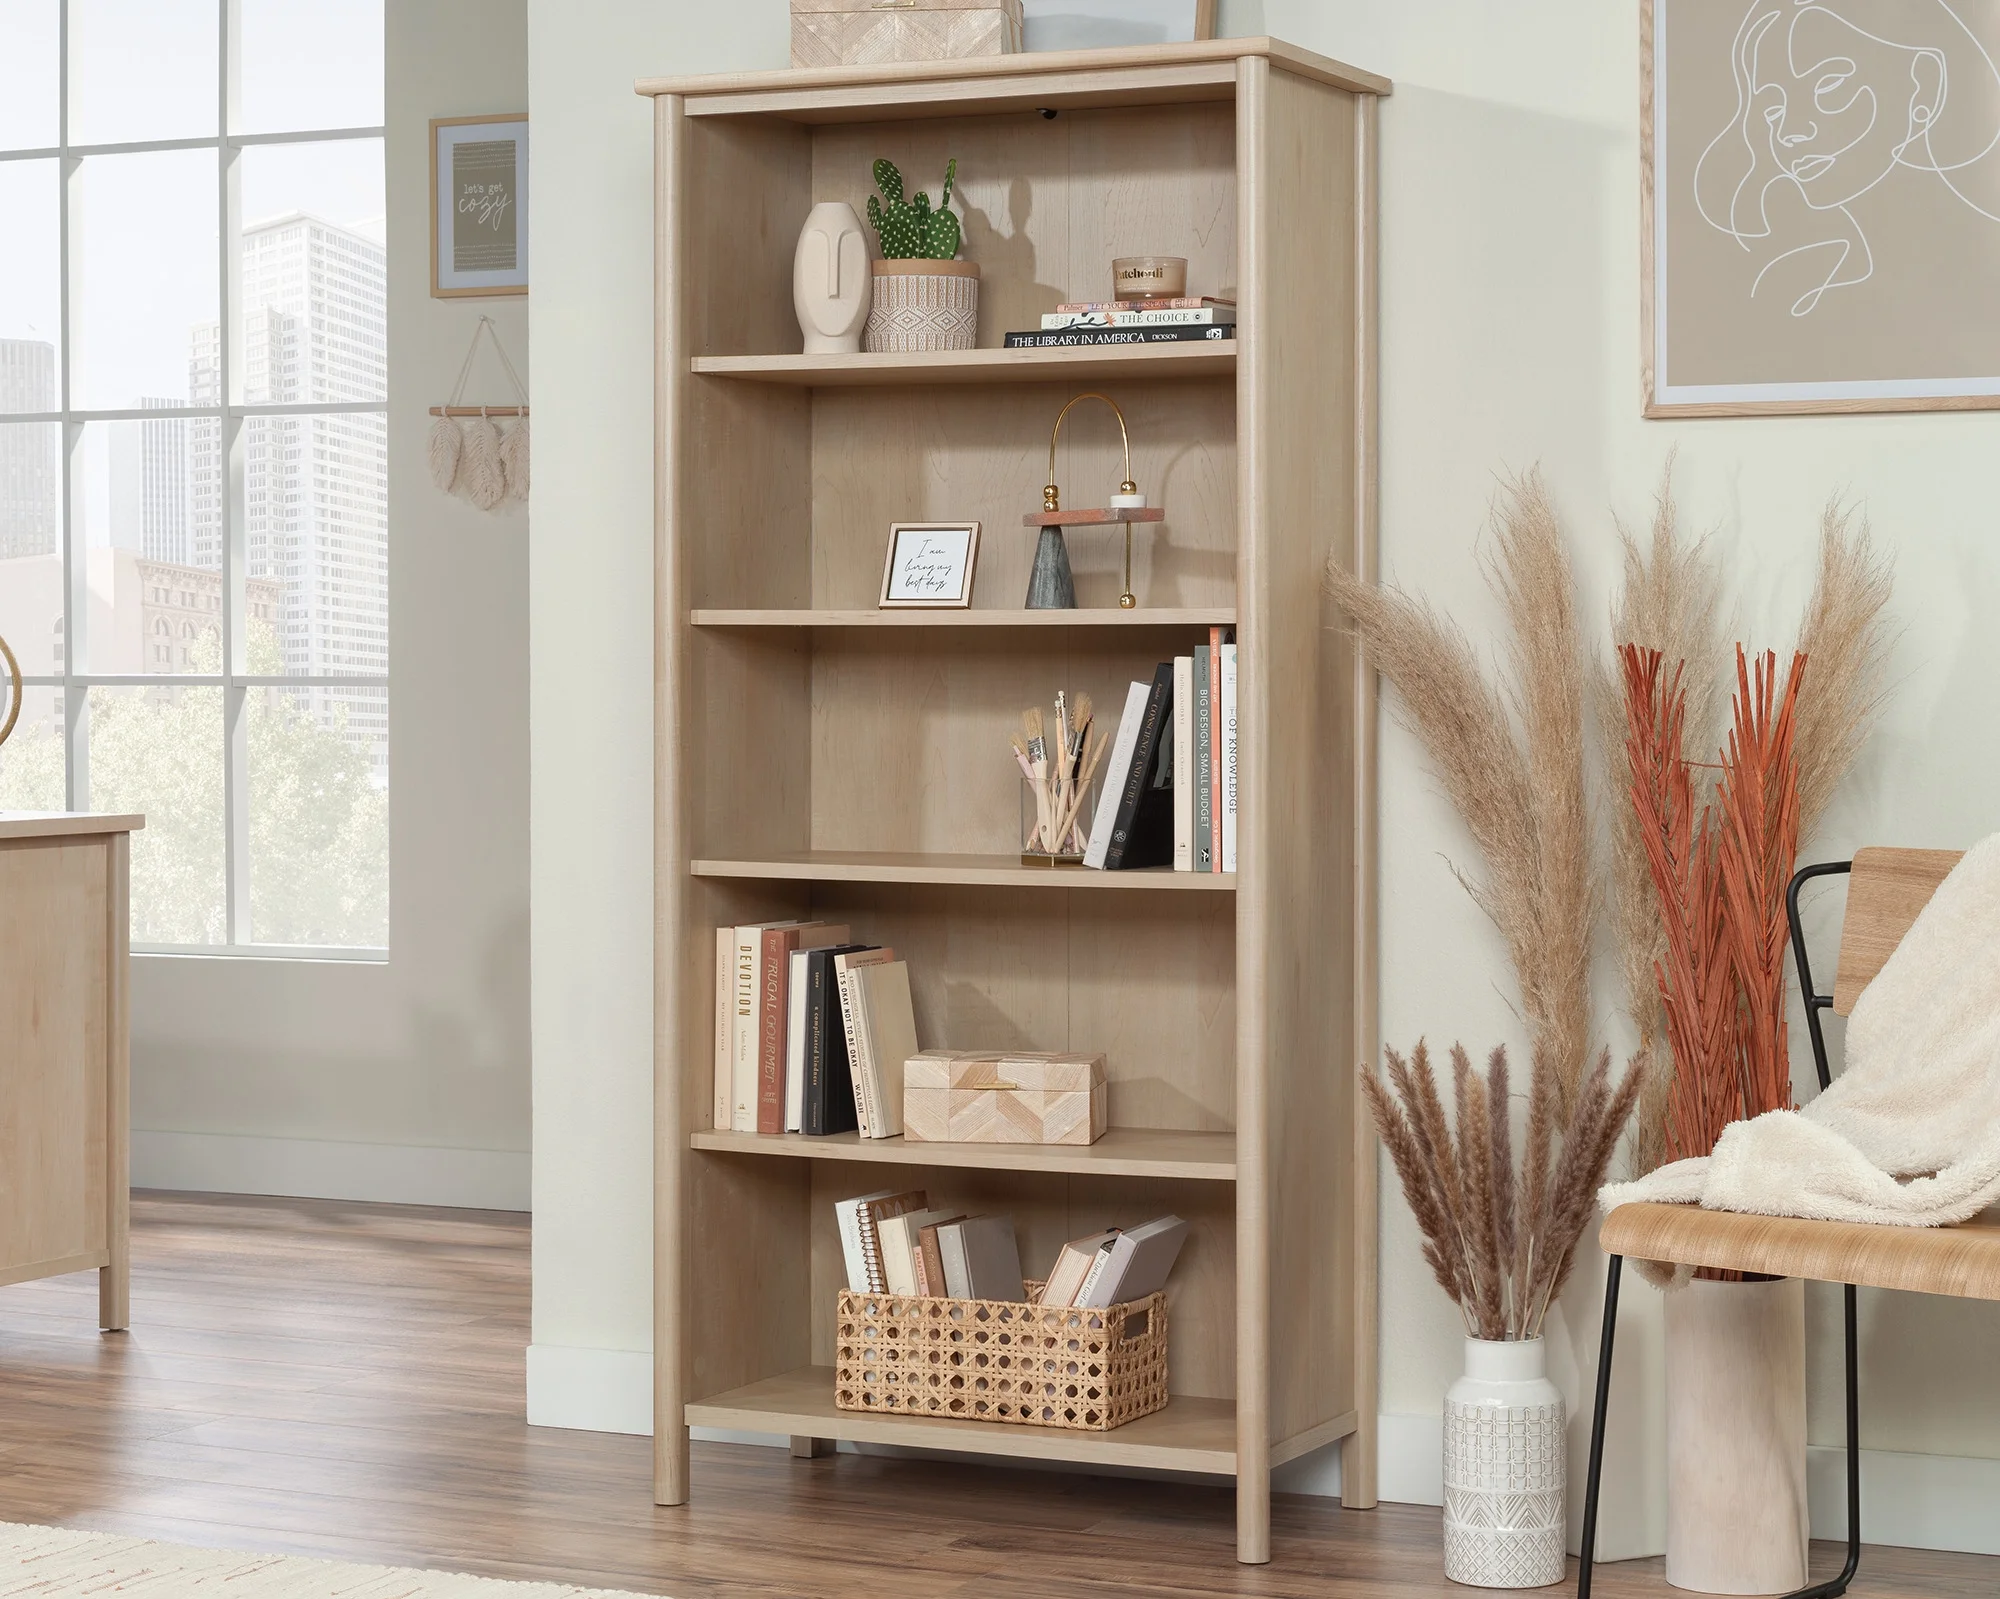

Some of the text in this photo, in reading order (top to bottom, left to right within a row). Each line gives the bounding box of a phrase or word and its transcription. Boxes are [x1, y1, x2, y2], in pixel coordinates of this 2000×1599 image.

[464, 181, 504, 196] let's get
[458, 193, 512, 232] cozy
[1106, 301, 1128, 310] YOUR
[1145, 299, 1169, 308] SPEAK
[1120, 312, 1190, 324] THE CHOICE
[1012, 332, 1146, 347] THE LIBRARY IN AMERICA
[916, 538, 932, 558] I
[936, 564, 952, 576] my
[905, 574, 930, 593] best
[1229, 718, 1237, 734] OF
[1125, 704, 1158, 806] CONSCIENCE AND GUILT
[1199, 690, 1209, 828] BIG DESIGN, SMALL BUDGET
[1229, 738, 1237, 814] KNOWLEDGE
[738, 946, 752, 1016] DEVOTION
[766, 956, 779, 1012] FRUGAL
[841, 988, 850, 1006] OKAY
[844, 1008, 852, 1022] NOT
[846, 1024, 854, 1035] TO
[765, 1014, 778, 1083] GOURMET
[848, 1038, 856, 1046] BE
[850, 1049, 858, 1068] OKAY
[855, 1084, 864, 1114] WALSH
[1080, 1285, 1091, 1301] Girl
